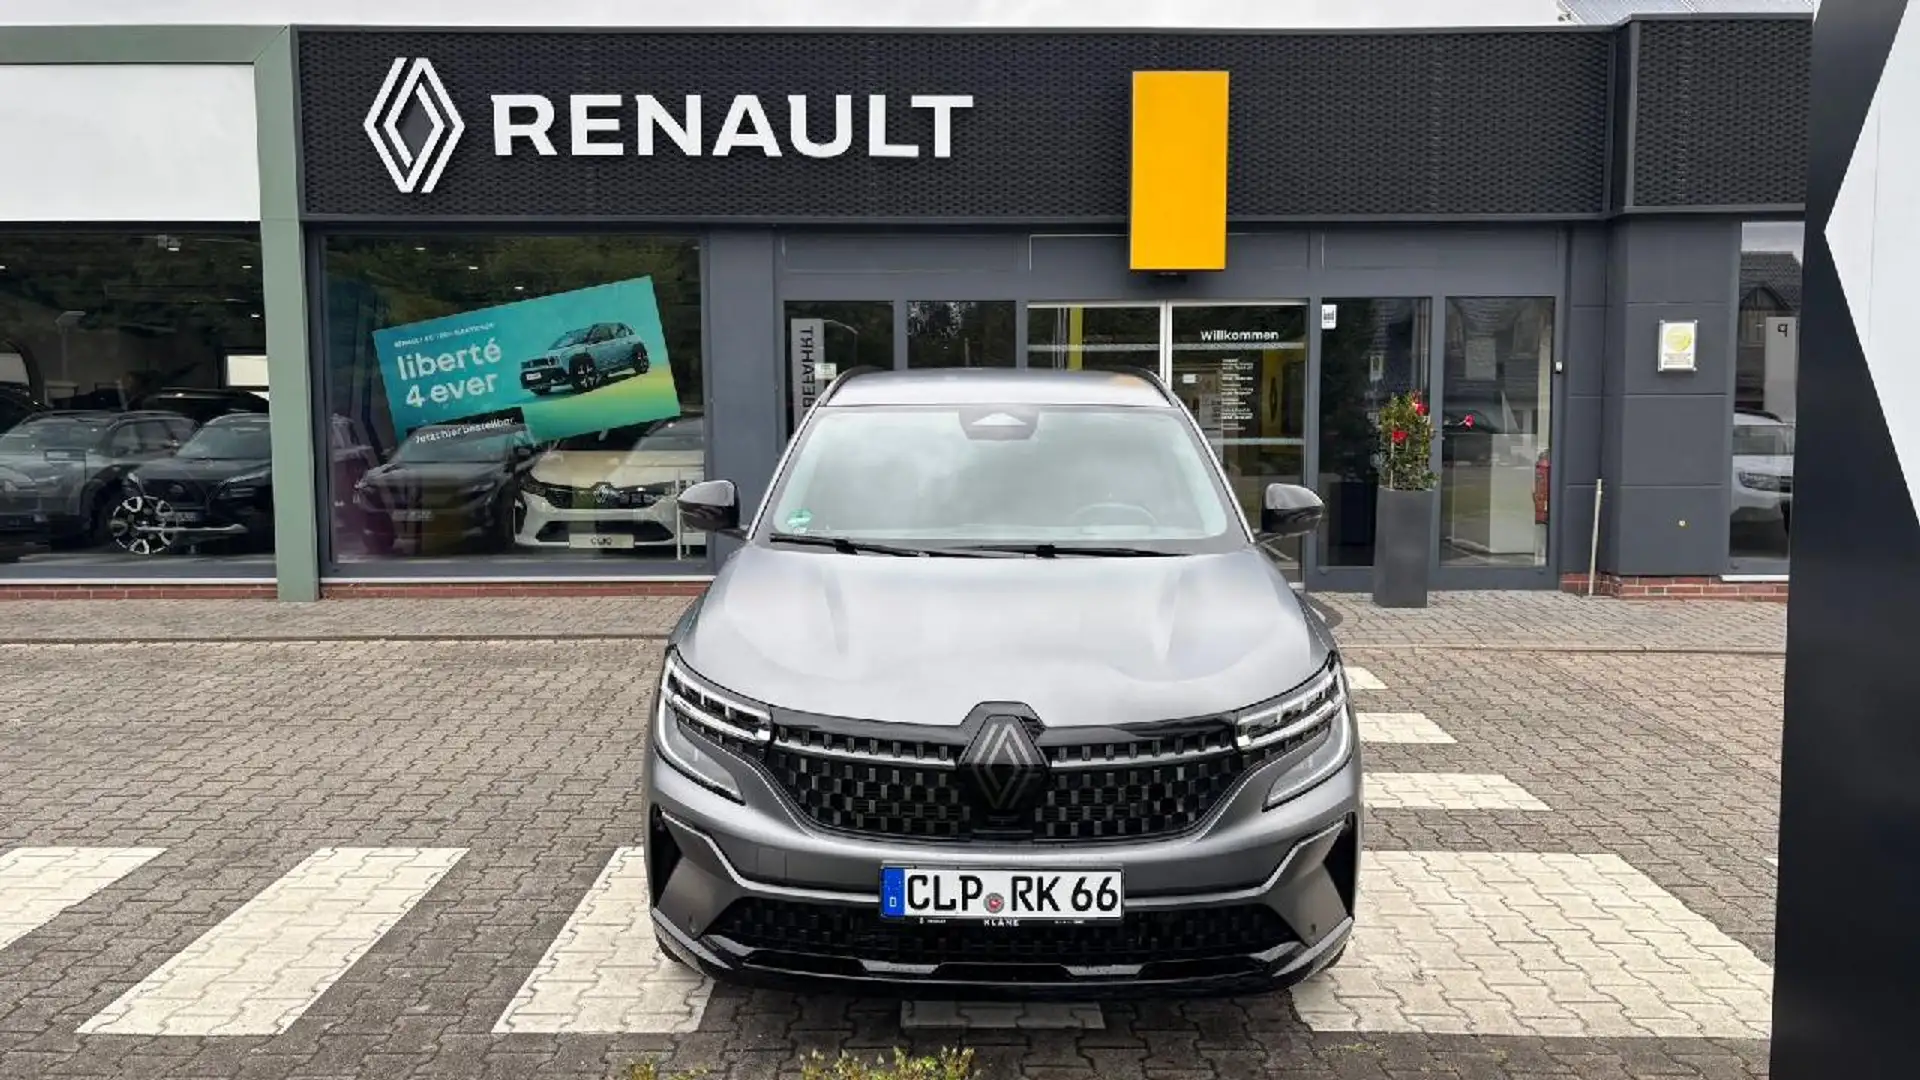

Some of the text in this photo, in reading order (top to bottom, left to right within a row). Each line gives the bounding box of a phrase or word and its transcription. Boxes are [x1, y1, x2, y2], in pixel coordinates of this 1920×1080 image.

[491, 94, 974, 158] RENAULT
[1200, 330, 1279, 341] Willkommen
[397, 336, 501, 381] liberté
[405, 373, 498, 408] 4 ever
[907, 874, 1118, 912] CLP RK 66
